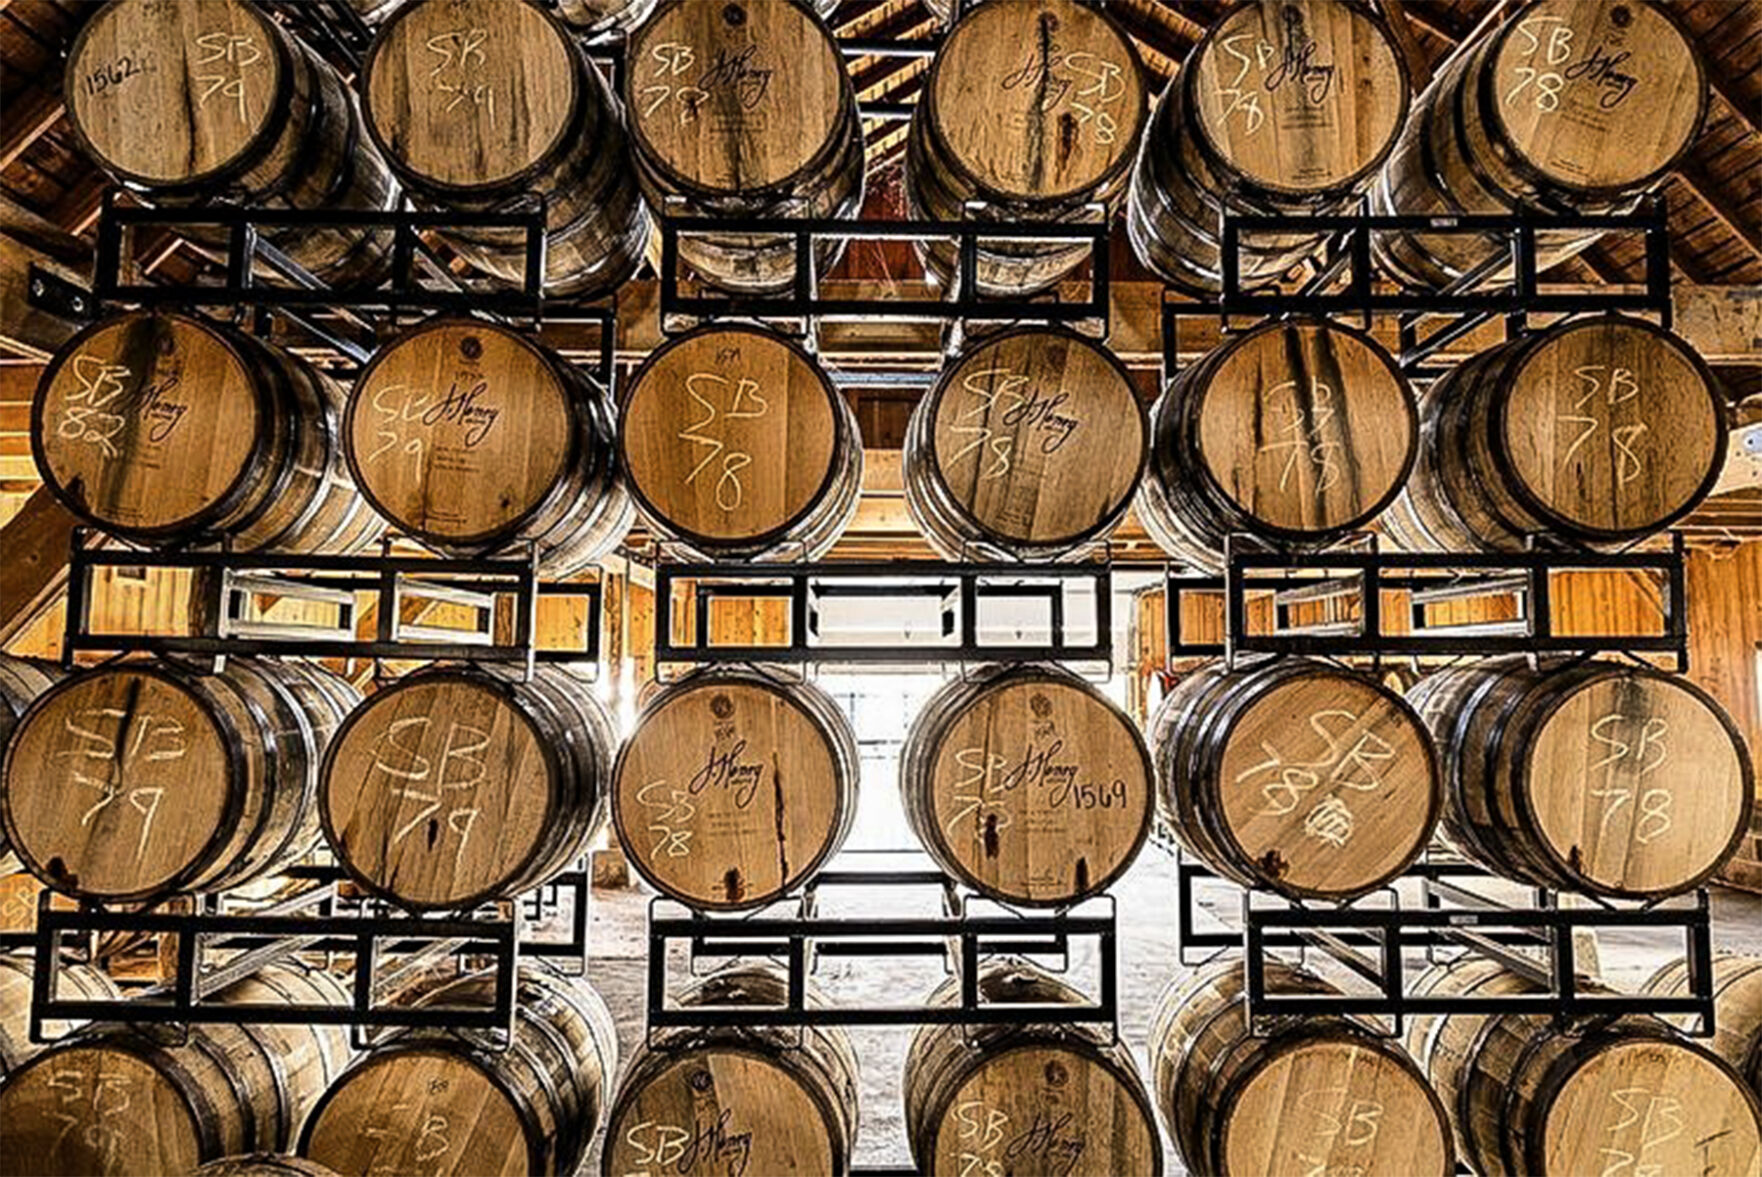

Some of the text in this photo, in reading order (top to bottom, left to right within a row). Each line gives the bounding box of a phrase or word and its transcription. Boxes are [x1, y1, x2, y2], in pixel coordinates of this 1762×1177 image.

[652, 42, 696, 77] SB
[1517, 15, 1575, 65] SB
[86, 56, 140, 96] 1562
[195, 75, 247, 125] 79
[1065, 51, 1127, 102] SB
[1505, 67, 1564, 112] 78
[1070, 102, 1117, 144] 78
[64, 354, 132, 407] SB
[685, 373, 769, 433] SB
[1574, 365, 1639, 410] SB
[367, 430, 422, 484] 79
[678, 433, 752, 511] 78
[945, 425, 1013, 480] 78
[1556, 415, 1649, 491] 78
[368, 717, 491, 797] SB
[1590, 714, 1669, 776] SB
[71, 770, 164, 868] 79
[391, 788, 482, 880] 79
[1590, 788, 1672, 844] 78
[648, 825, 693, 861] 78
[626, 1119, 690, 1166] SB
[950, 1101, 1010, 1153] SB
[1606, 1087, 1690, 1150] SB
